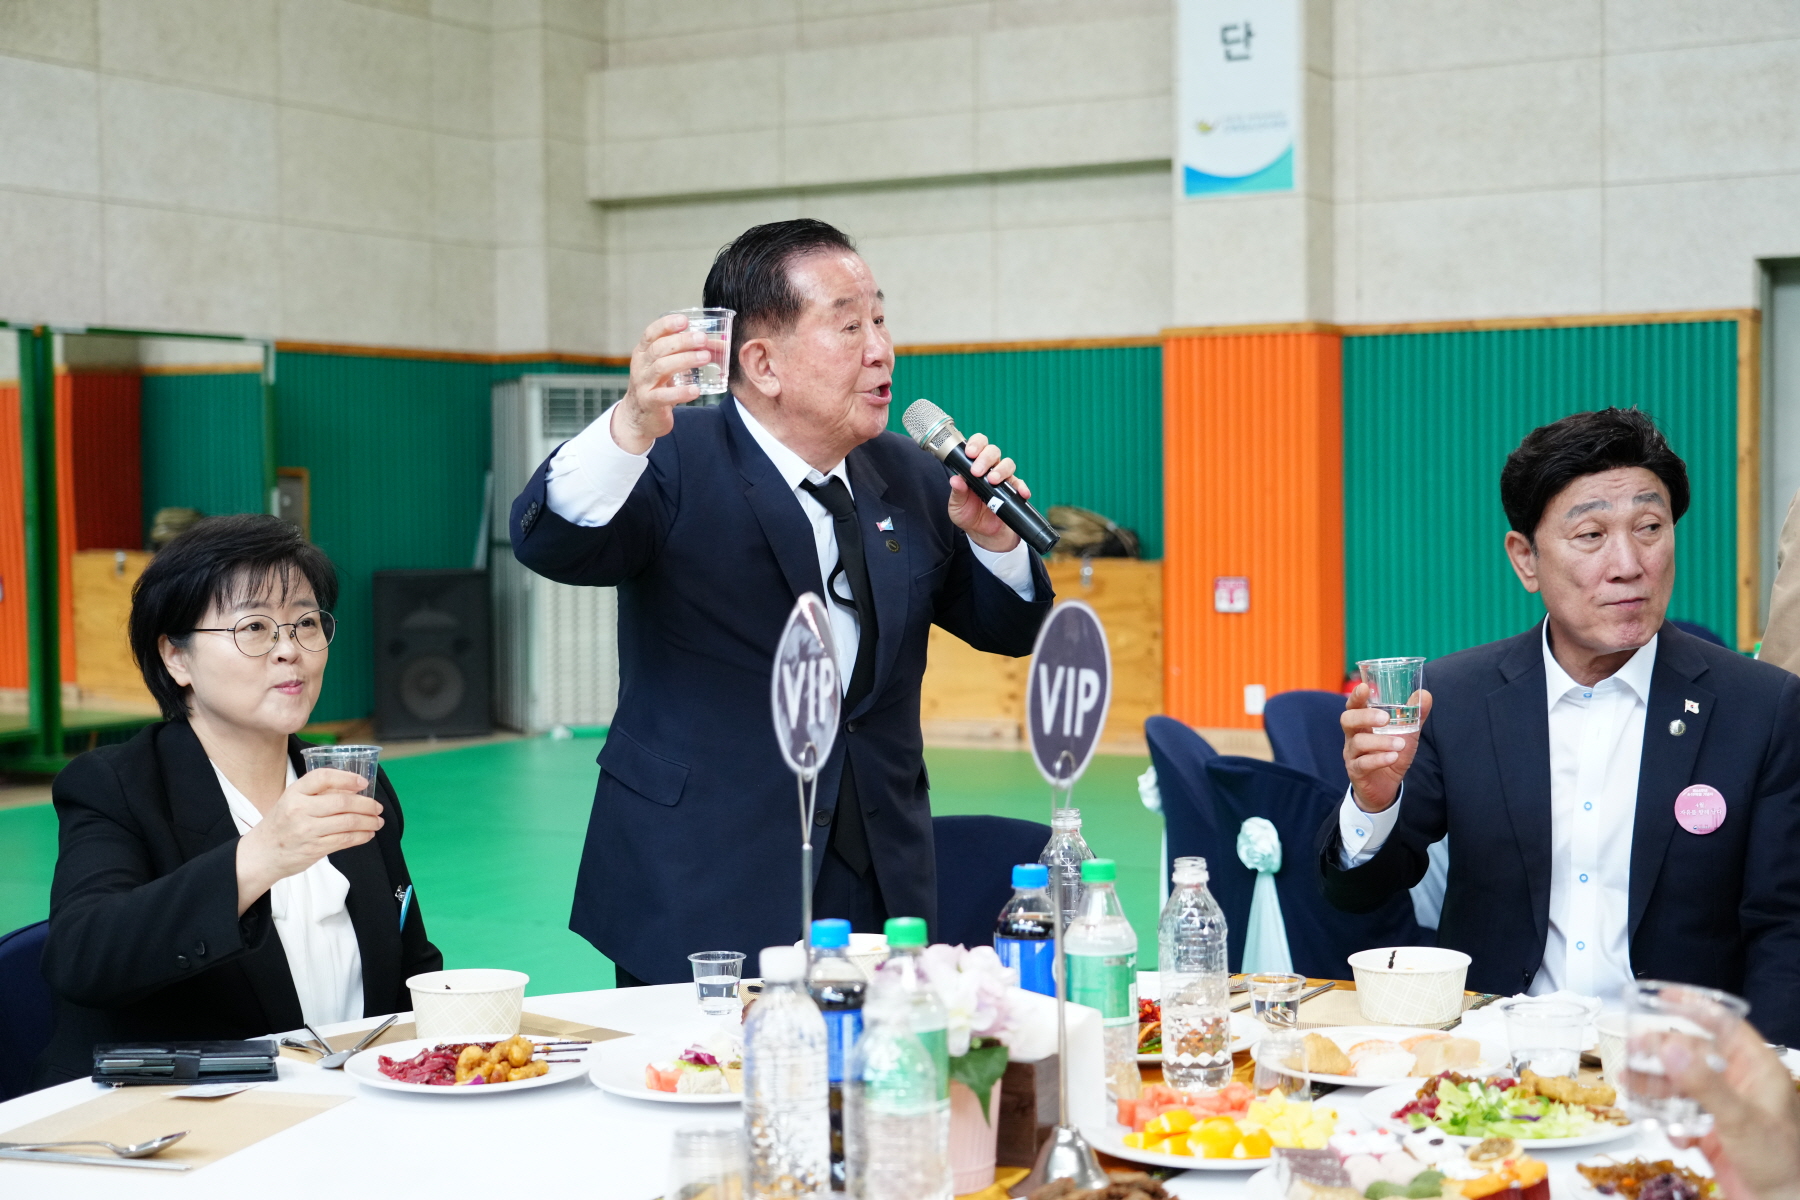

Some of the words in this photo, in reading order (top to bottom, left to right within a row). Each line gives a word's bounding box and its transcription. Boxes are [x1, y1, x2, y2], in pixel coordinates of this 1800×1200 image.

[1220, 21, 1255, 62] 단
[781, 656, 835, 729] VIP
[1038, 662, 1101, 738] VIP
